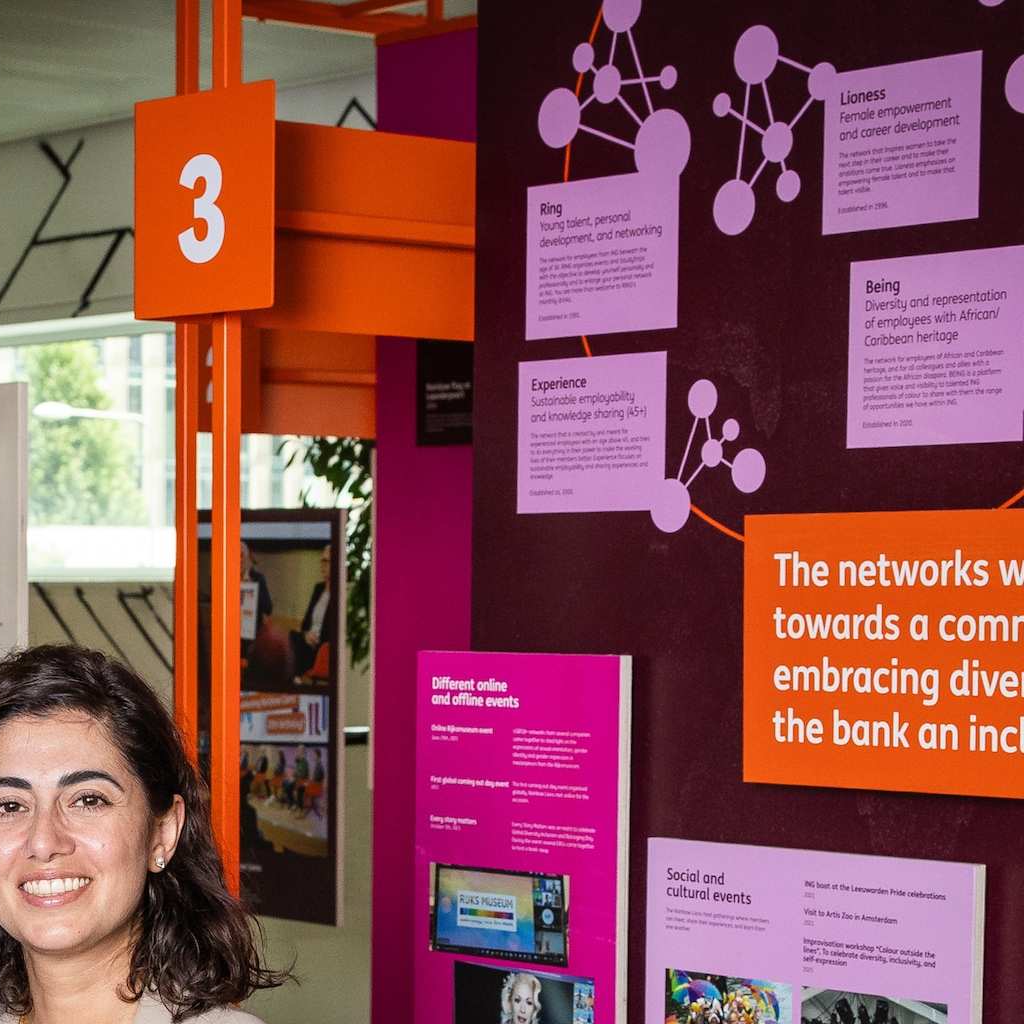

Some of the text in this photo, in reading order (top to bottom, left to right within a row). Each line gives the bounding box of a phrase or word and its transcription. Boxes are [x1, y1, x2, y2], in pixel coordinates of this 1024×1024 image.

[840, 89, 886, 105] Lioness
[840, 96, 952, 123] Female empowerment
[840, 114, 960, 141] and career development
[178, 154, 226, 264] 3
[540, 202, 562, 217] Ring
[540, 210, 631, 232] Young talent, personal
[540, 224, 662, 248] development, and networking
[866, 278, 900, 295] Being
[866, 289, 1007, 312] Diversity and representation
[865, 307, 1000, 329] of employees with African/
[864, 330, 958, 346] Caribbean heritage
[532, 377, 586, 393] Experience
[532, 391, 635, 407] Sustainable employability
[531, 406, 647, 423] and knowledge sharing (45+)
[774, 551, 829, 586] The
[839, 549, 989, 586] networks
[773, 604, 900, 640] towards
[910, 614, 928, 641] a
[432, 676, 508, 693] Different online
[773, 656, 1024, 706] embracing dive
[432, 692, 520, 708] and offline events
[773, 707, 823, 743] the
[833, 709, 910, 748] bank
[918, 723, 958, 750] an
[667, 868, 724, 885] Social and
[667, 884, 751, 904] cultural events
[804, 880, 815, 888] ING
[816, 881, 830, 889] boat
[840, 883, 850, 891] the
[851, 885, 888, 895] Leeuwarden
[890, 888, 906, 897] Pride
[907, 891, 946, 900] celebrations
[482, 897, 513, 908] MUSEUM
[804, 908, 817, 916] Visit
[826, 911, 840, 919] Artis
[842, 912, 853, 920] Zoo
[862, 915, 897, 924] Amsterdam
[803, 937, 844, 948] Improvisation
[846, 941, 874, 953] workshop
[900, 948, 923, 958] outside
[925, 951, 935, 959] the
[822, 948, 829, 956] To
[830, 950, 858, 959] celebrate
[924, 960, 936, 968] and
[803, 955, 847, 966] self-expression
